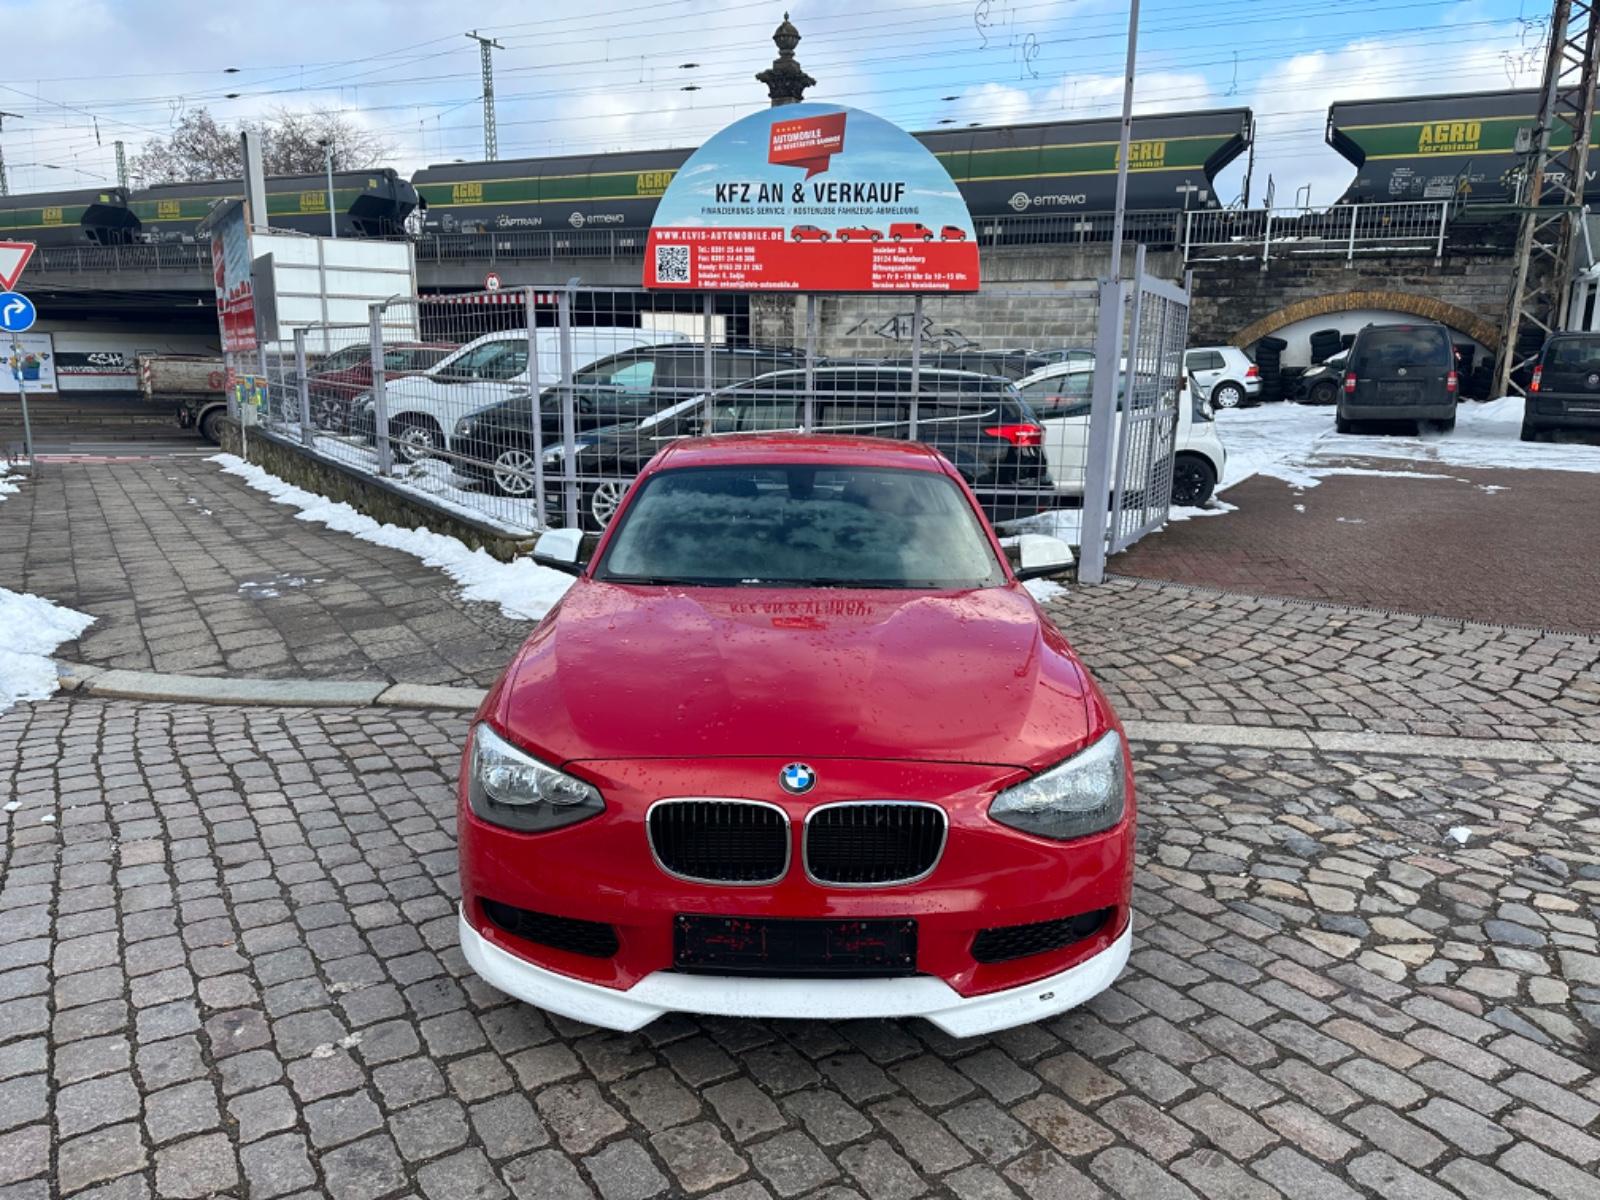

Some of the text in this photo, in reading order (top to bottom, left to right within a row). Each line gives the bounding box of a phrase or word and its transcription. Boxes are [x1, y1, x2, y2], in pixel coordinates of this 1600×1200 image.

[773, 128, 822, 145] AUTOMOBILE
[1419, 123, 1482, 144] AGRO
[636, 172, 672, 188] AGRO
[452, 183, 483, 197] AGRO
[715, 182, 906, 203] KFZ AN & VERKAUF
[1033, 194, 1087, 206] ermewa
[793, 206, 836, 215] KOSTENLOSE
[838, 206, 919, 215] FAHRZEUG-ABMELDUNG
[655, 231, 783, 241] WWW.ELVIS-AUTOMOBILE.DE
